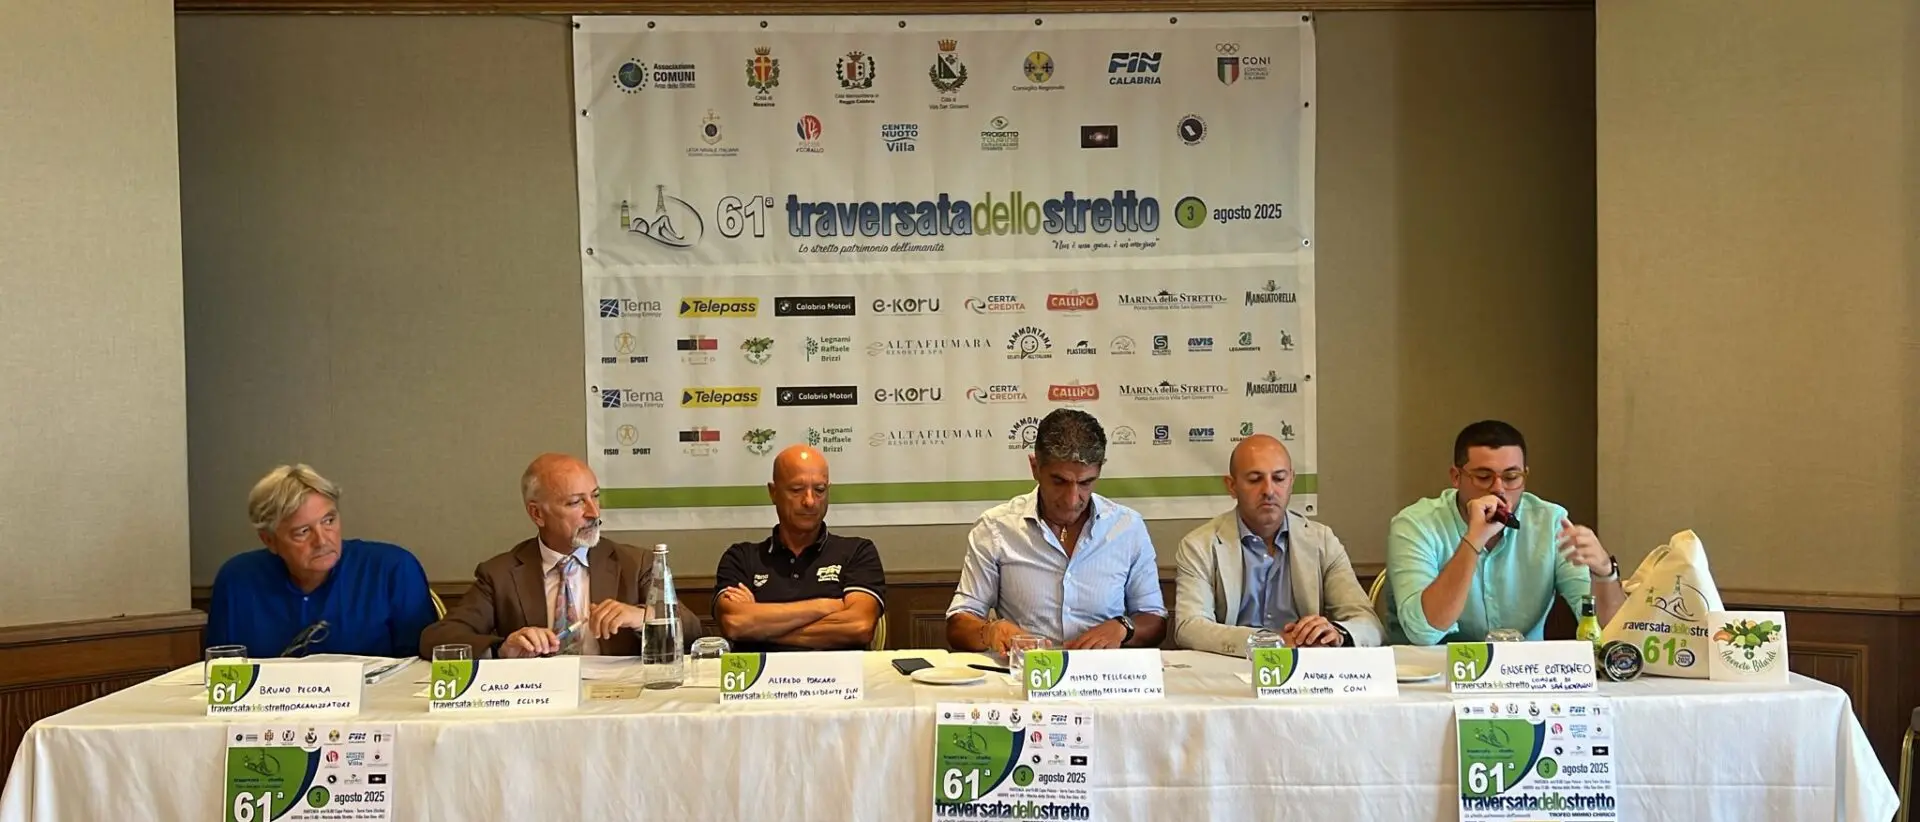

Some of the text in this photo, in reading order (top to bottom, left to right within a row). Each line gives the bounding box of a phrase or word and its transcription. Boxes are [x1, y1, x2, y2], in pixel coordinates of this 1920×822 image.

[1108, 52, 1162, 73] FIN
[1242, 56, 1271, 65] CONI
[653, 71, 695, 82] COMUNI
[1109, 76, 1161, 85] CALABRIA
[886, 142, 915, 152] Villa
[1187, 204, 1282, 224] 3 agosto 2025
[810, 244, 838, 252] stretto
[840, 244, 888, 254] patrimonio
[890, 242, 944, 252] dell'umanità
[1052, 297, 1094, 307] CALLIPO
[1118, 294, 1157, 304] MARINA
[1180, 293, 1222, 302] STRETTO
[1245, 292, 1296, 306] MANGIATORELLA
[621, 299, 661, 311] Terna
[693, 300, 755, 315] Telepass
[886, 338, 991, 349] ALTAFIUMARA
[1007, 326, 1052, 350] SAMMONTANA
[1188, 337, 1213, 346] AVIS
[1053, 387, 1095, 397] CALLIPO
[1120, 385, 1158, 394] MARINA
[1180, 383, 1223, 392] STRETTO
[1246, 382, 1297, 396] MANGIATORELLA
[623, 389, 663, 401] Terna
[695, 390, 758, 405] Telepass
[888, 429, 992, 439] ALTAFIUMARA
[1008, 417, 1042, 440] SAMMON
[1189, 428, 1214, 436] AVIS
[1500, 663, 1592, 675] GIUSEPPE COTRONEO
[260, 686, 290, 695] BRUNO
[1544, 763, 1608, 776] 3 agosto 2025
[1021, 771, 1086, 785] 3 agosto 2025
[316, 791, 384, 805] 3 agosto 2025
